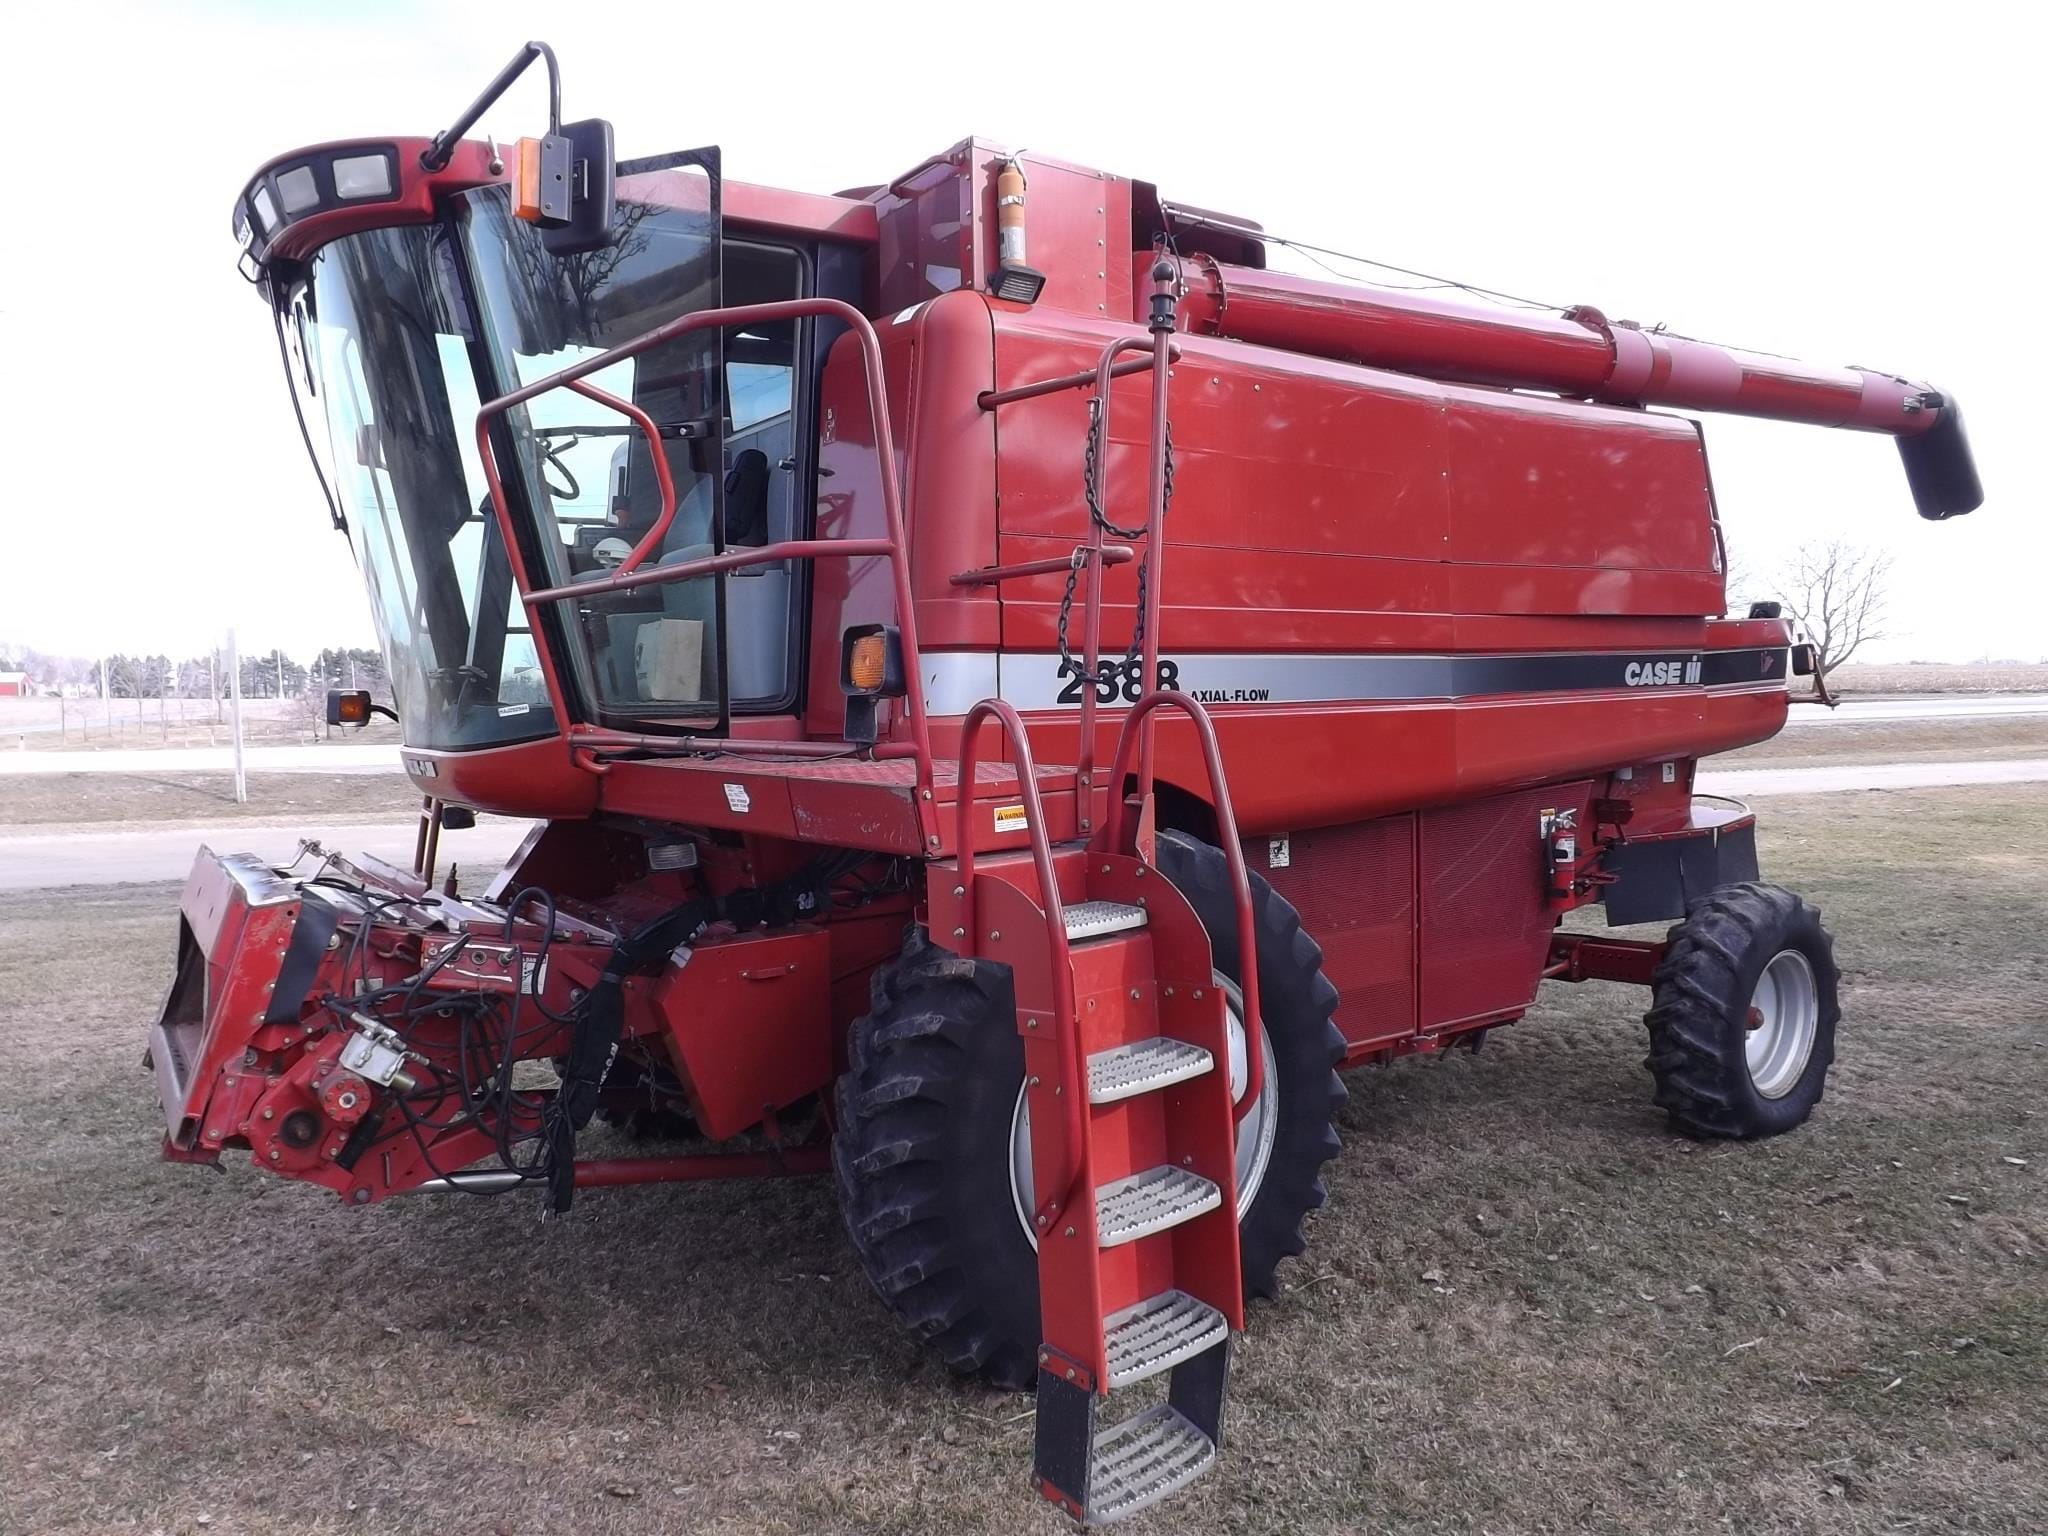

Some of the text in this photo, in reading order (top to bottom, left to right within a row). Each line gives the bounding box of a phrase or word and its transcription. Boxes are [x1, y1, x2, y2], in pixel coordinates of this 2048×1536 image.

[1057, 660, 1179, 704] 2388
[1625, 661, 1682, 687] CASE
[1191, 689, 1270, 703] AXIAL-FLOW
